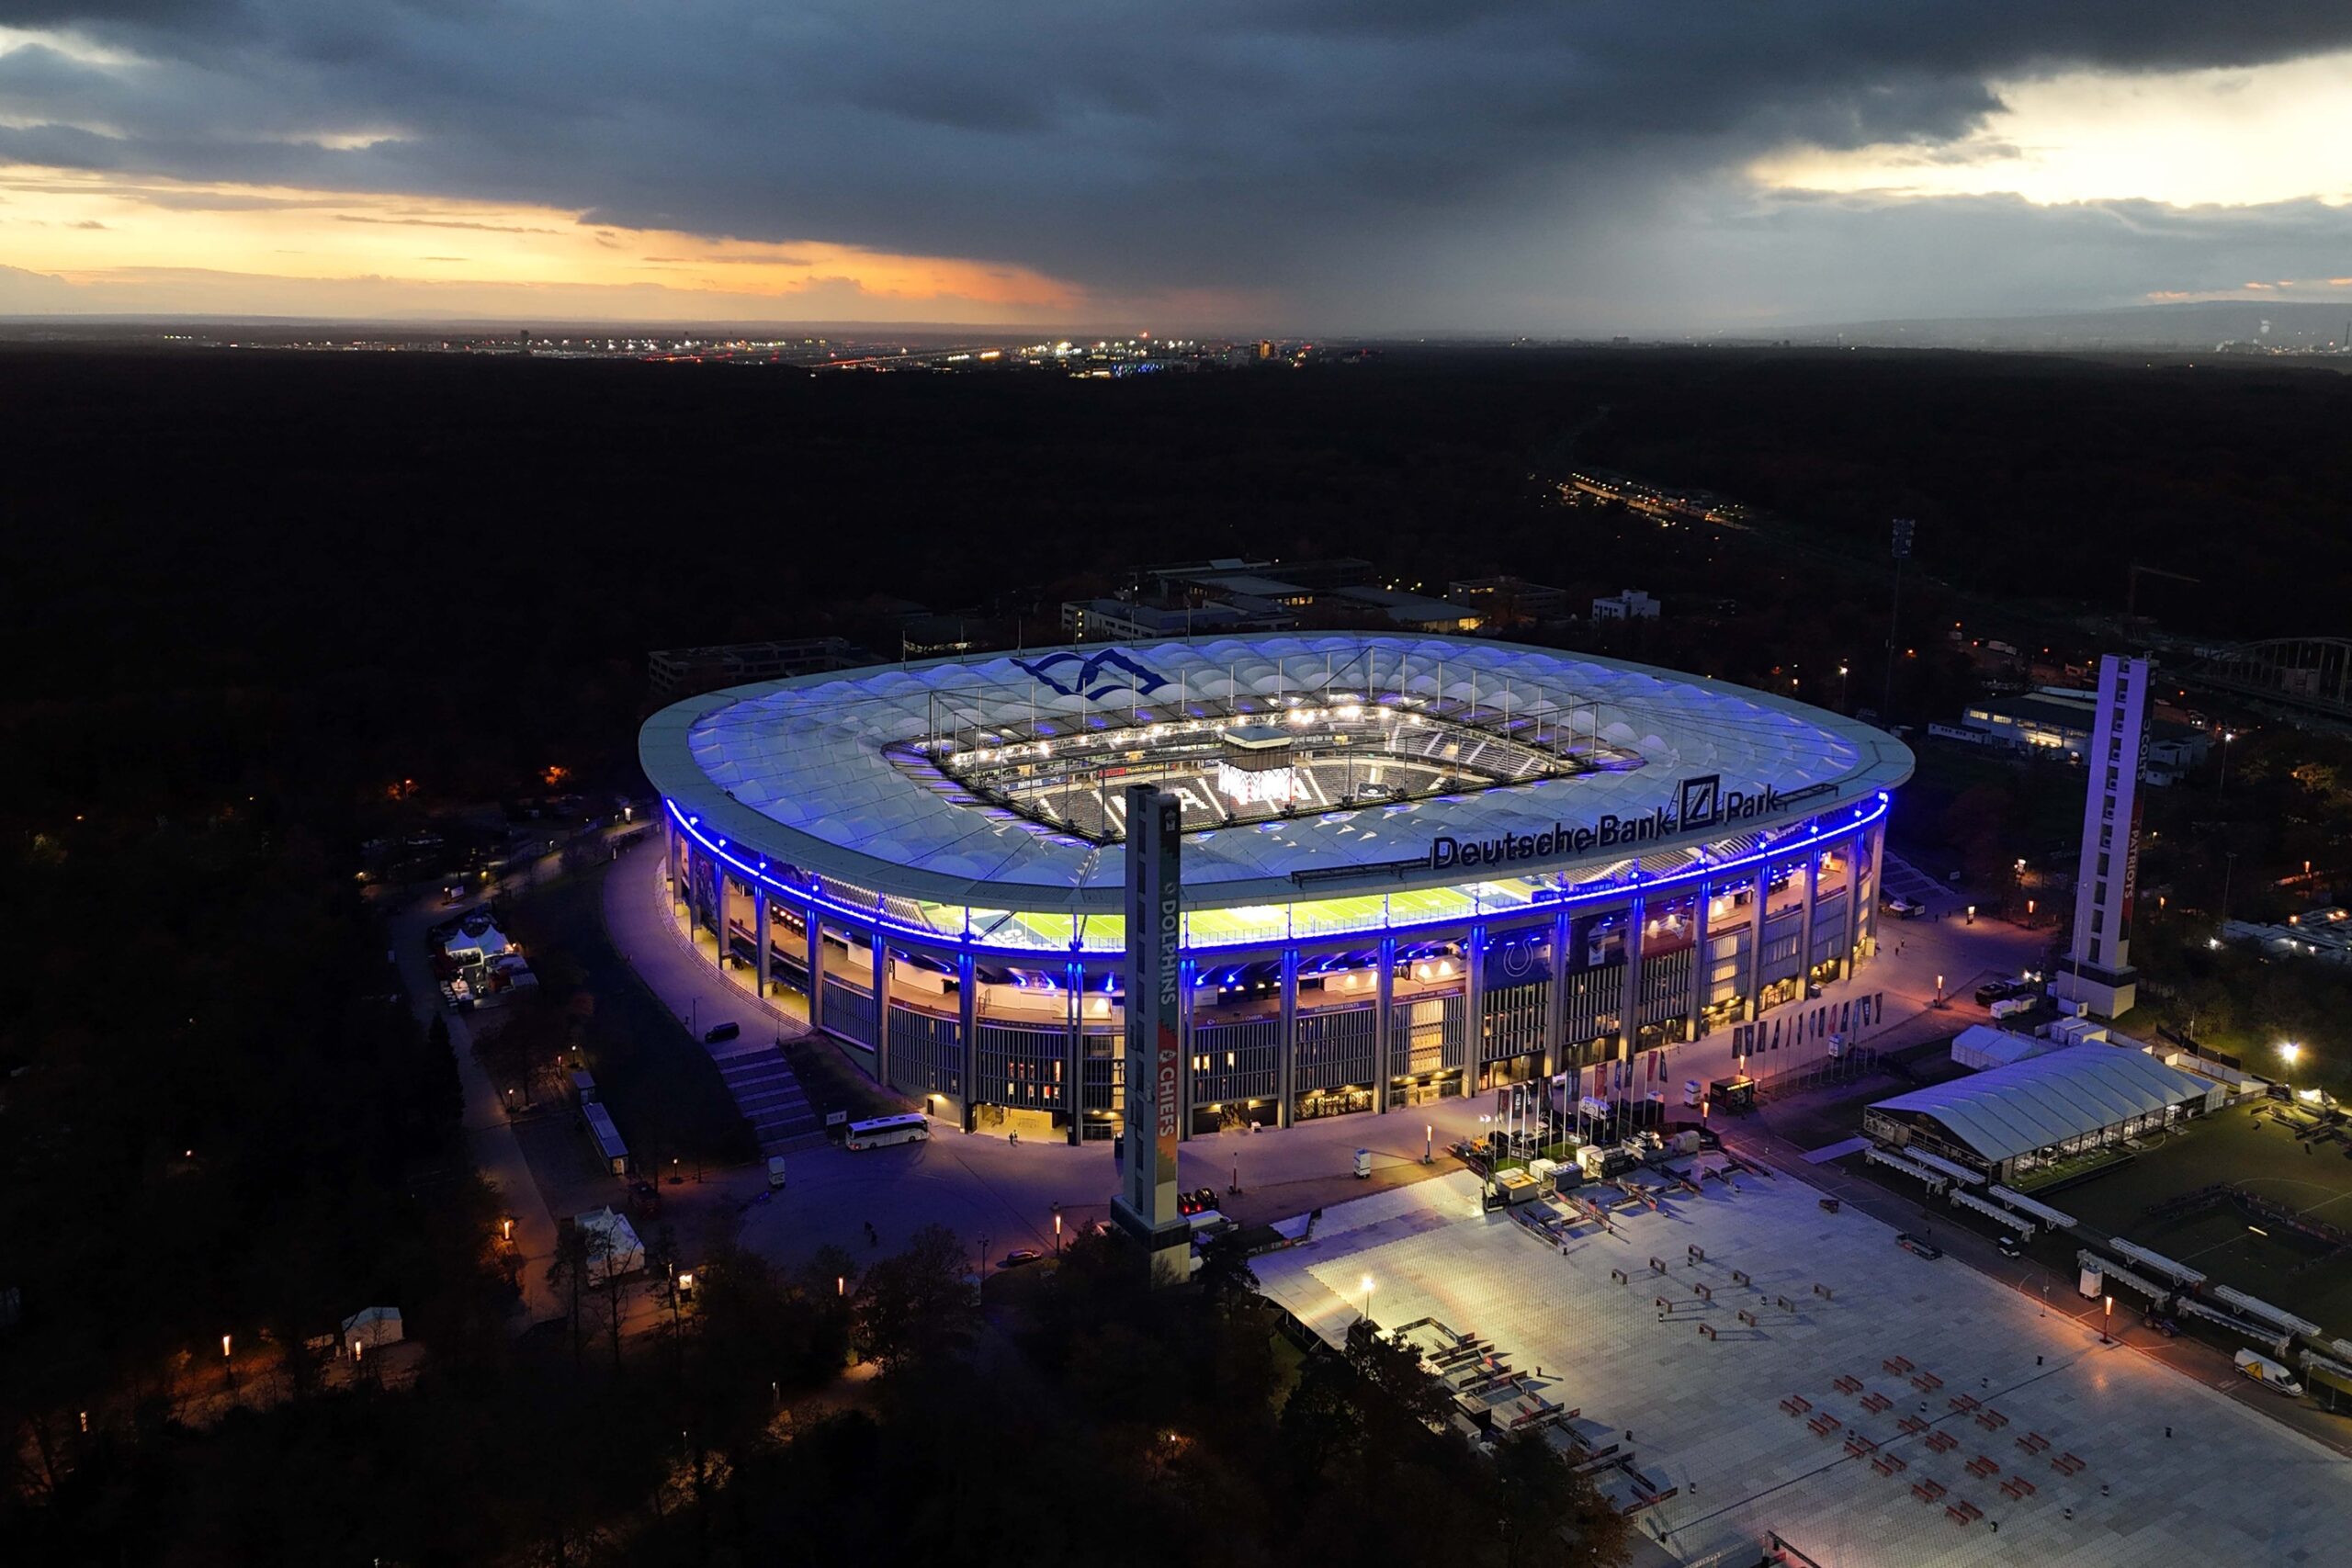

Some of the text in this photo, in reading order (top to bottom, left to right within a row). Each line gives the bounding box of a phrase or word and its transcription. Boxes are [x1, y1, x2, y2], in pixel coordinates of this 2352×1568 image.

[1018, 778, 1043, 789] PATROTS
[2137, 733, 2151, 781] COLTS
[1430, 784, 1779, 871] Deutsche Bank Park
[2124, 829, 2140, 899] PATRIOTS
[1160, 899, 1177, 1005] DOLPHINS
[1159, 1066, 1175, 1138] CHIEFS
